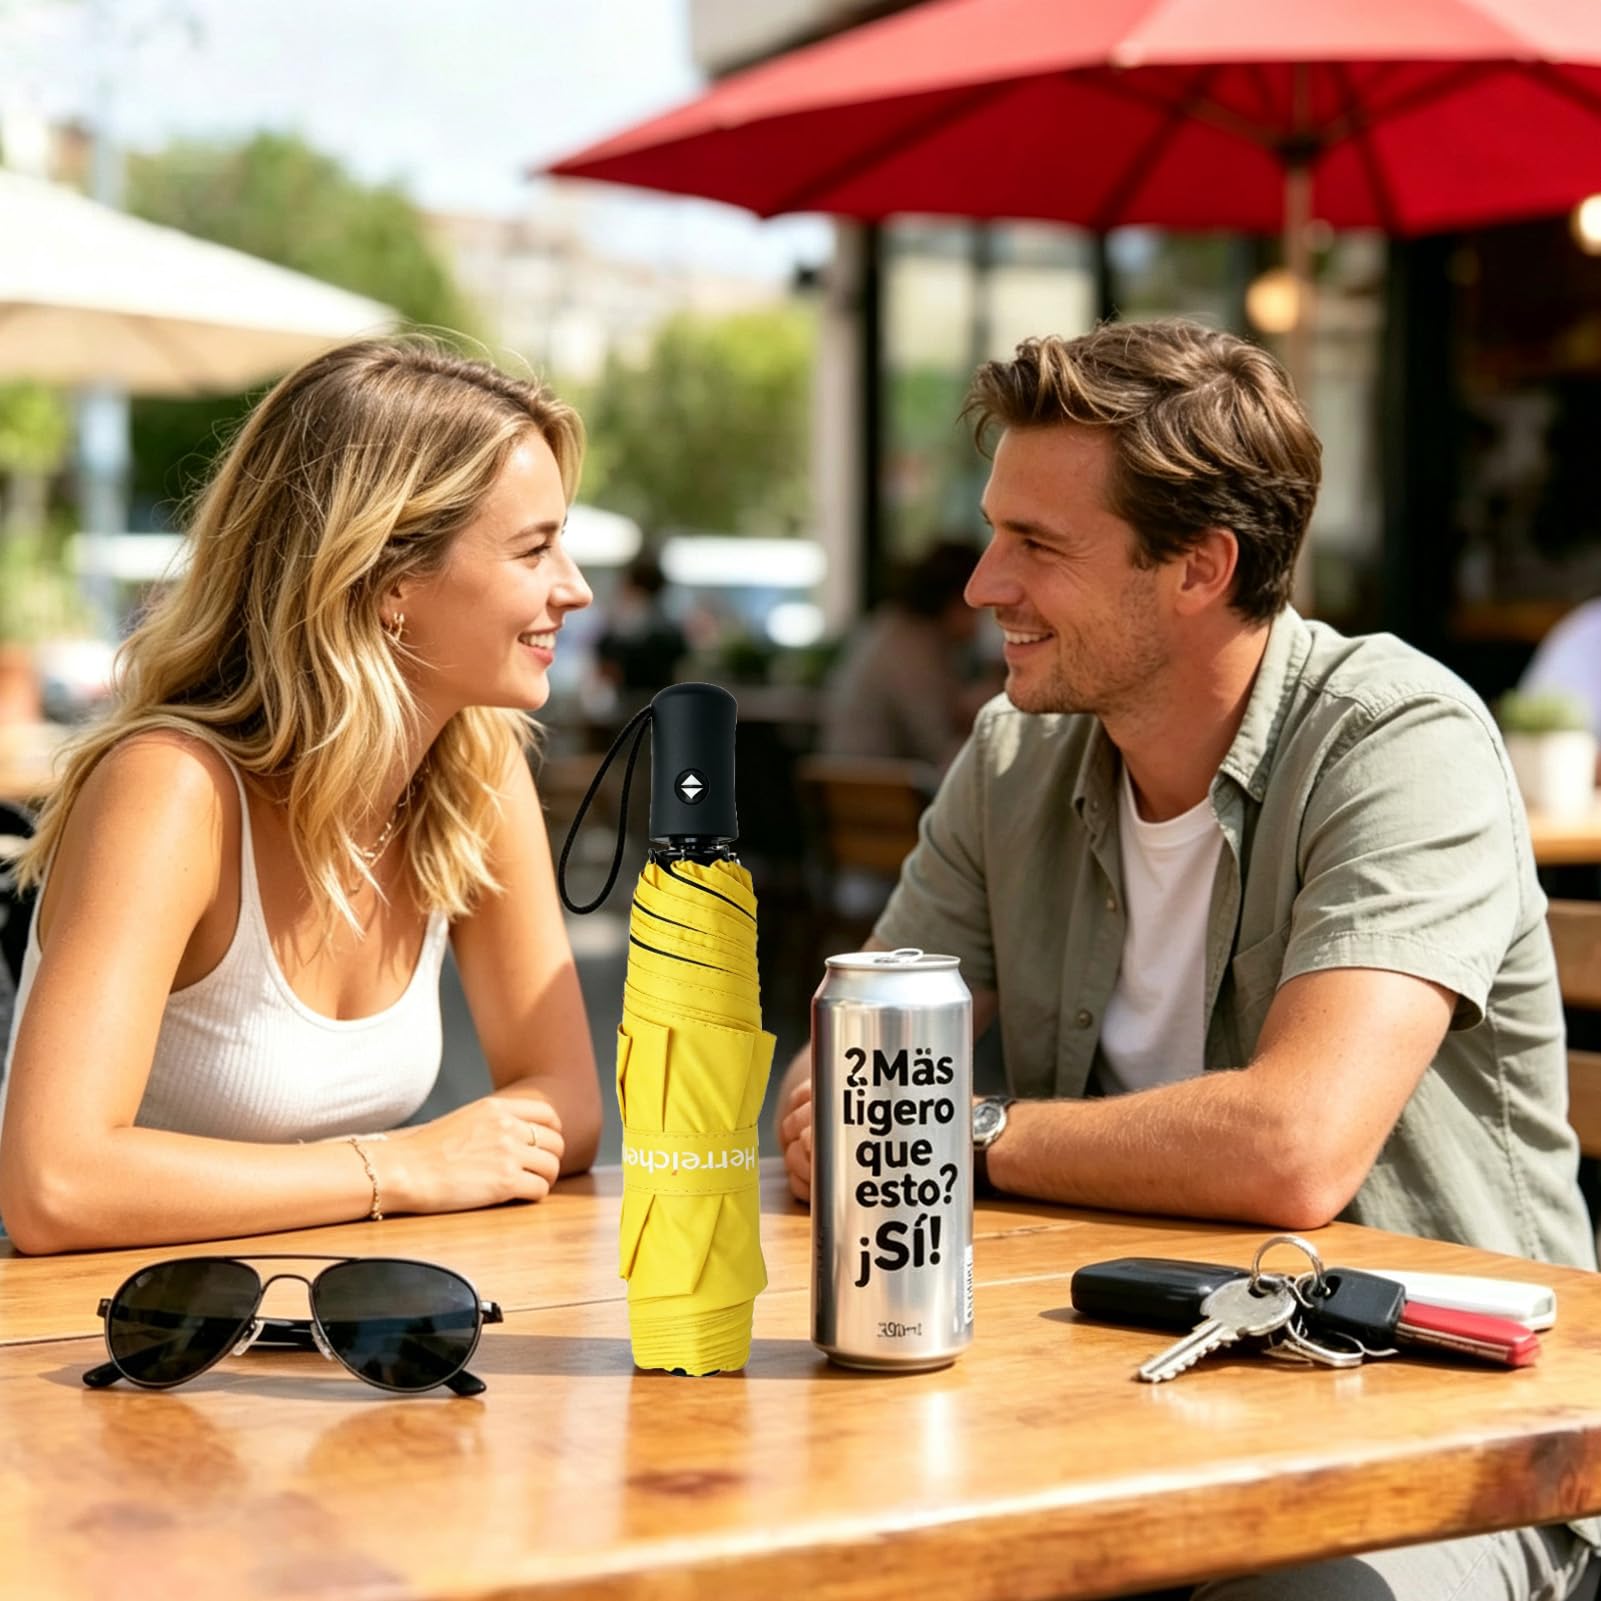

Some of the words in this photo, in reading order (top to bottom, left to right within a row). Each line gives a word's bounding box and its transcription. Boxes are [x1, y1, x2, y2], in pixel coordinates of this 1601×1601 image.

[843, 1088, 955, 1137] ligero
[855, 1139, 933, 1177] que
[855, 1163, 958, 1208] esto?
